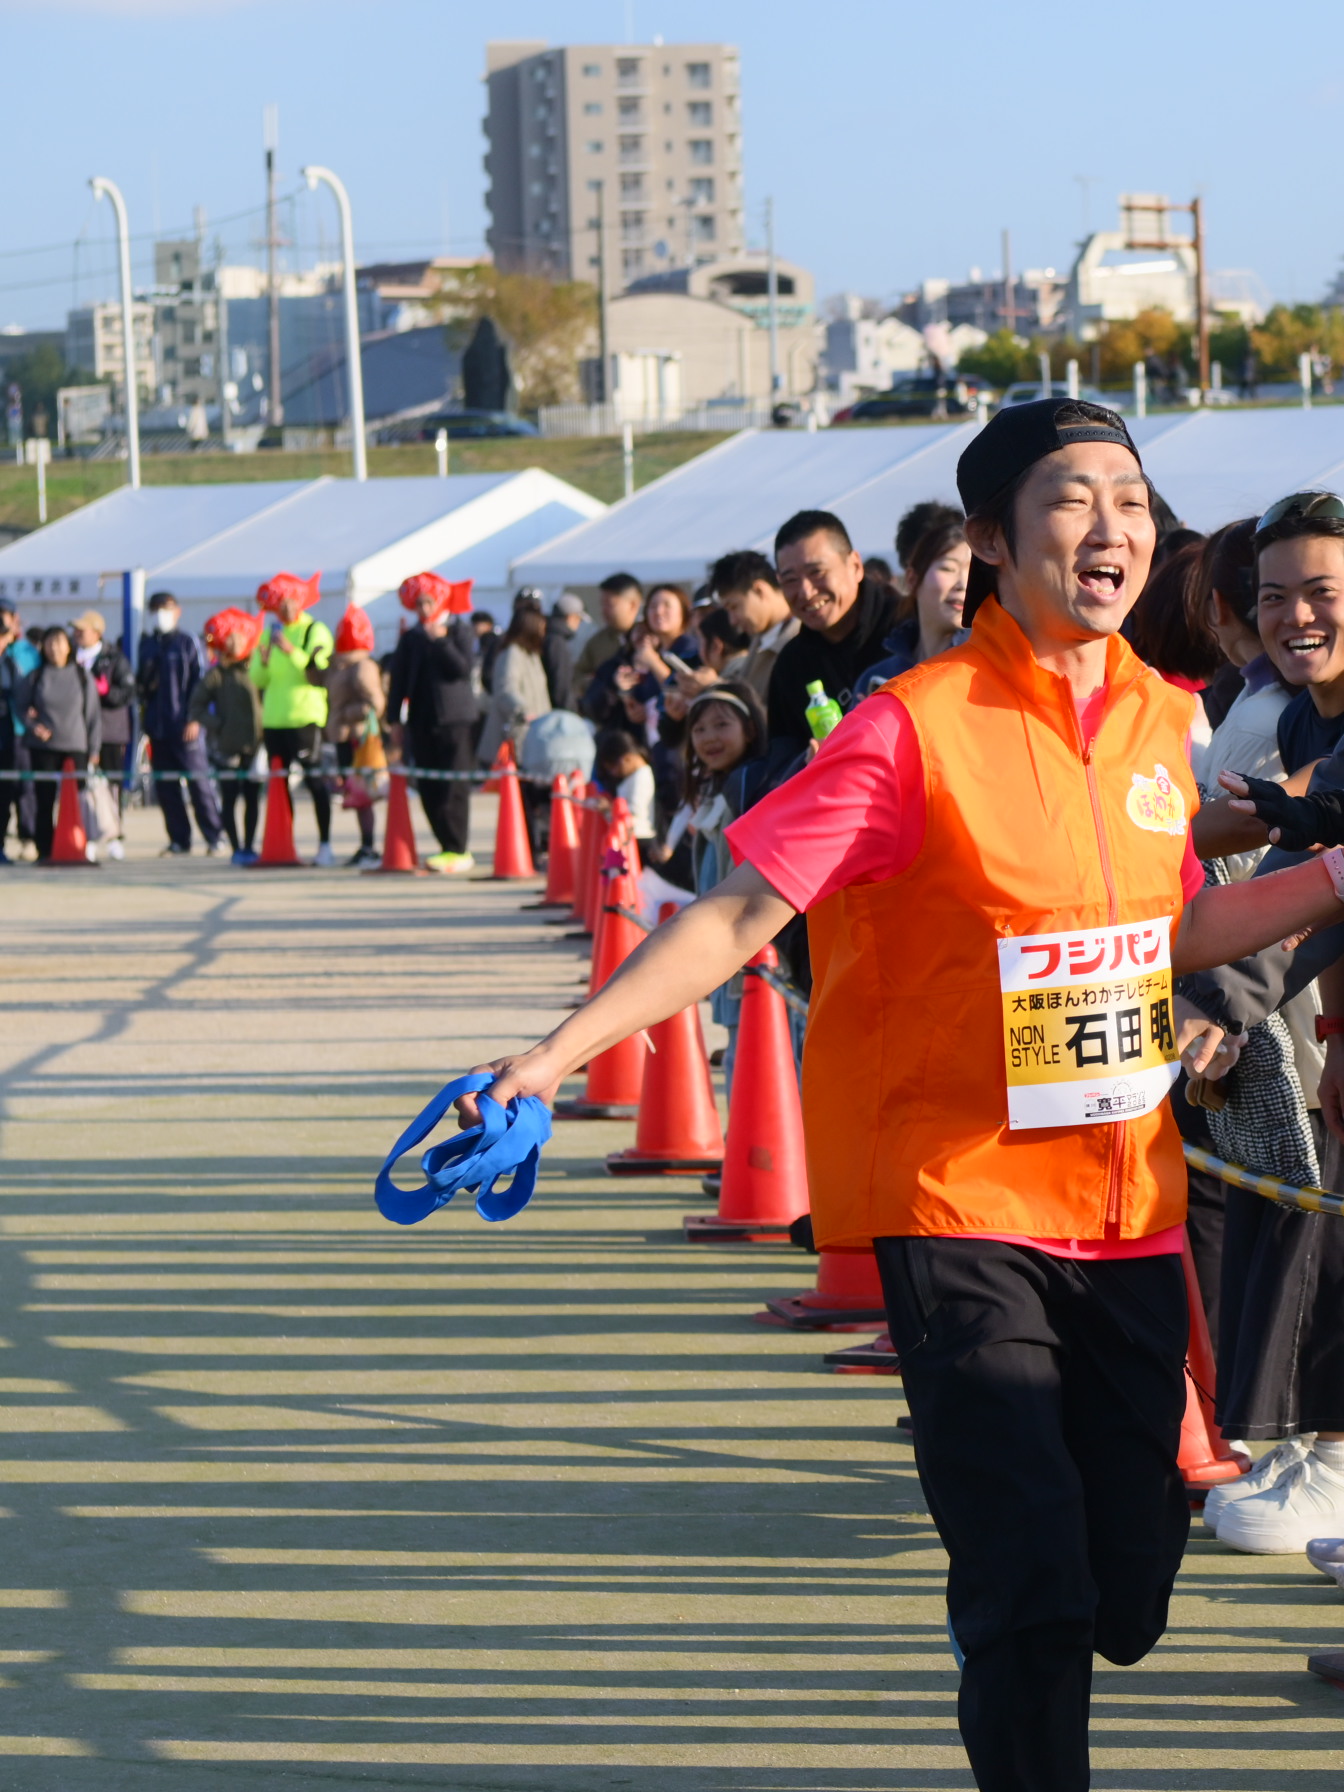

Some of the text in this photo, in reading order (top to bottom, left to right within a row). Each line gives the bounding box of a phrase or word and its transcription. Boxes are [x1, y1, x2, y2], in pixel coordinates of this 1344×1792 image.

[1021, 929, 1161, 980] フジパン
[1012, 974, 1168, 1013] 大阪ほんわかテレビチーム
[1010, 1025, 1044, 1047] NON
[1065, 998, 1174, 1068] 石田明
[1011, 1044, 1061, 1067] STYLE
